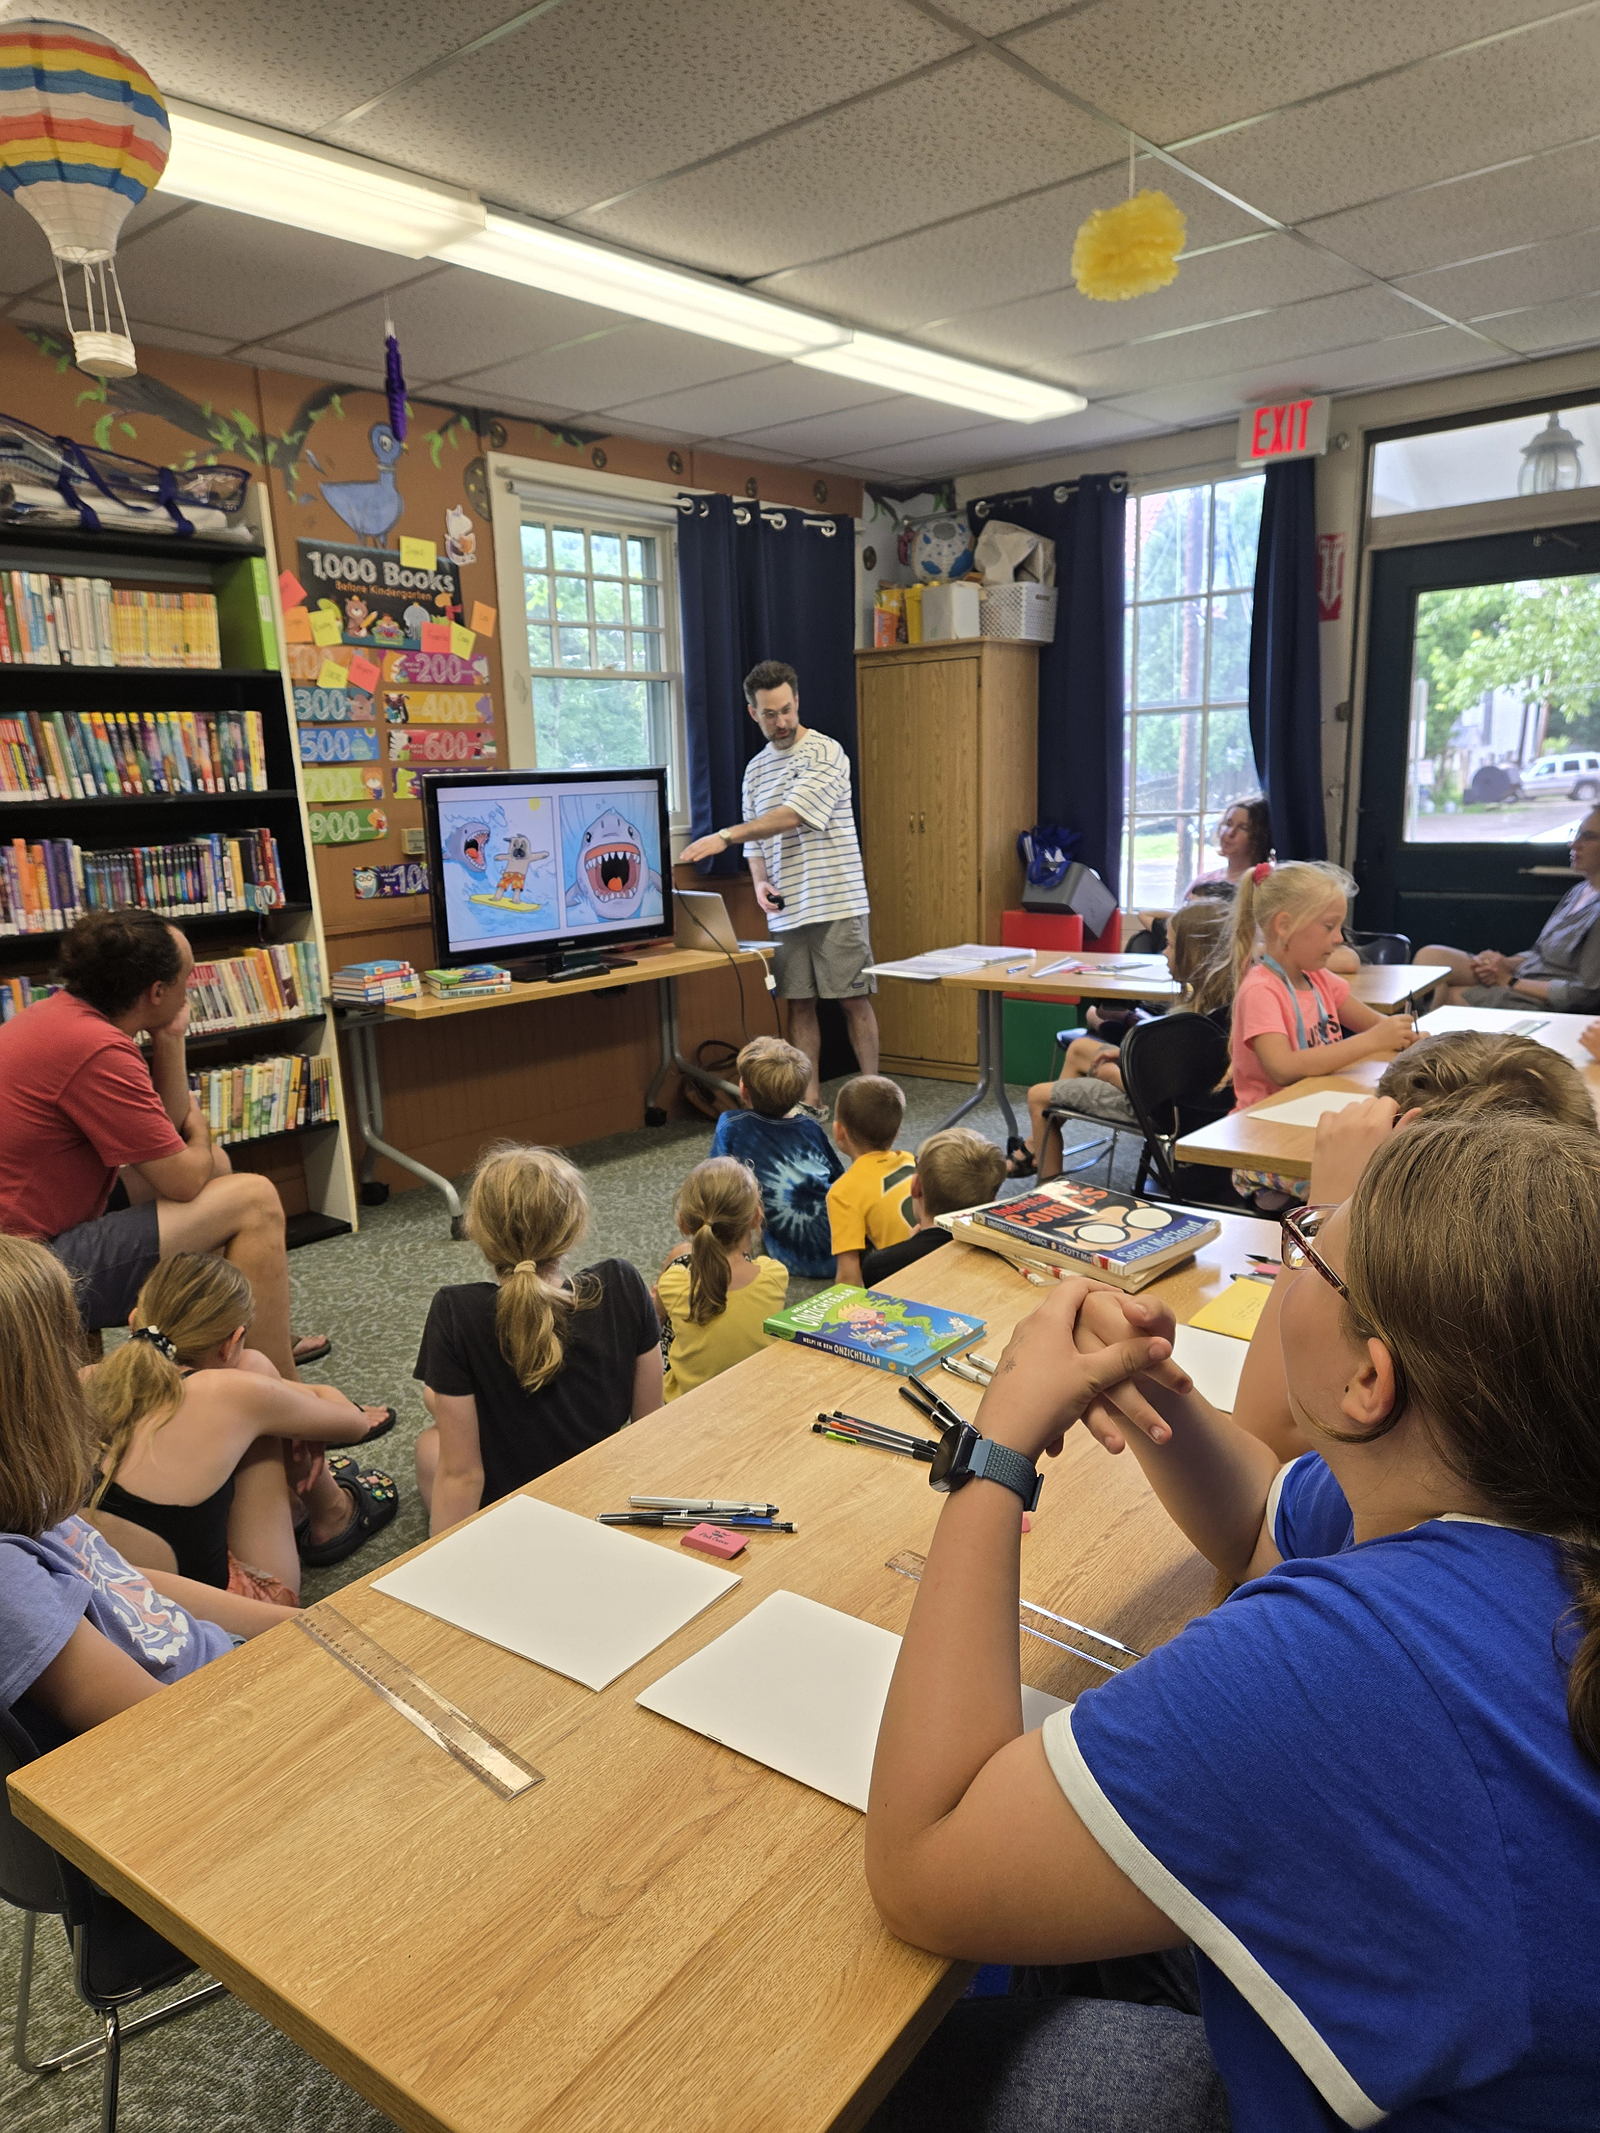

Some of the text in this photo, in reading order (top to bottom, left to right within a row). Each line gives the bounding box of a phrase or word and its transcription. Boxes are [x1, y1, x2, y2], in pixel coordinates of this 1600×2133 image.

[1251, 399, 1314, 458] EXIT
[306, 551, 455, 592] 1,000 Books
[414, 653, 462, 684] 200
[294, 689, 345, 721] 300
[420, 694, 468, 721] 400
[300, 730, 350, 760] 500
[425, 731, 468, 760] 600
[304, 769, 353, 800] 700
[308, 811, 360, 842] 900
[987, 1219, 1027, 1239] UNDERSTANDING
[1027, 1234, 1048, 1247] COMICS
[1058, 1244, 1080, 1259] SCOTT
[1117, 1220, 1204, 1261] Scott McCloud
[790, 1288, 859, 1327] ONZICHTBAAR
[833, 1344, 881, 1367] ONZICHTBAAR
